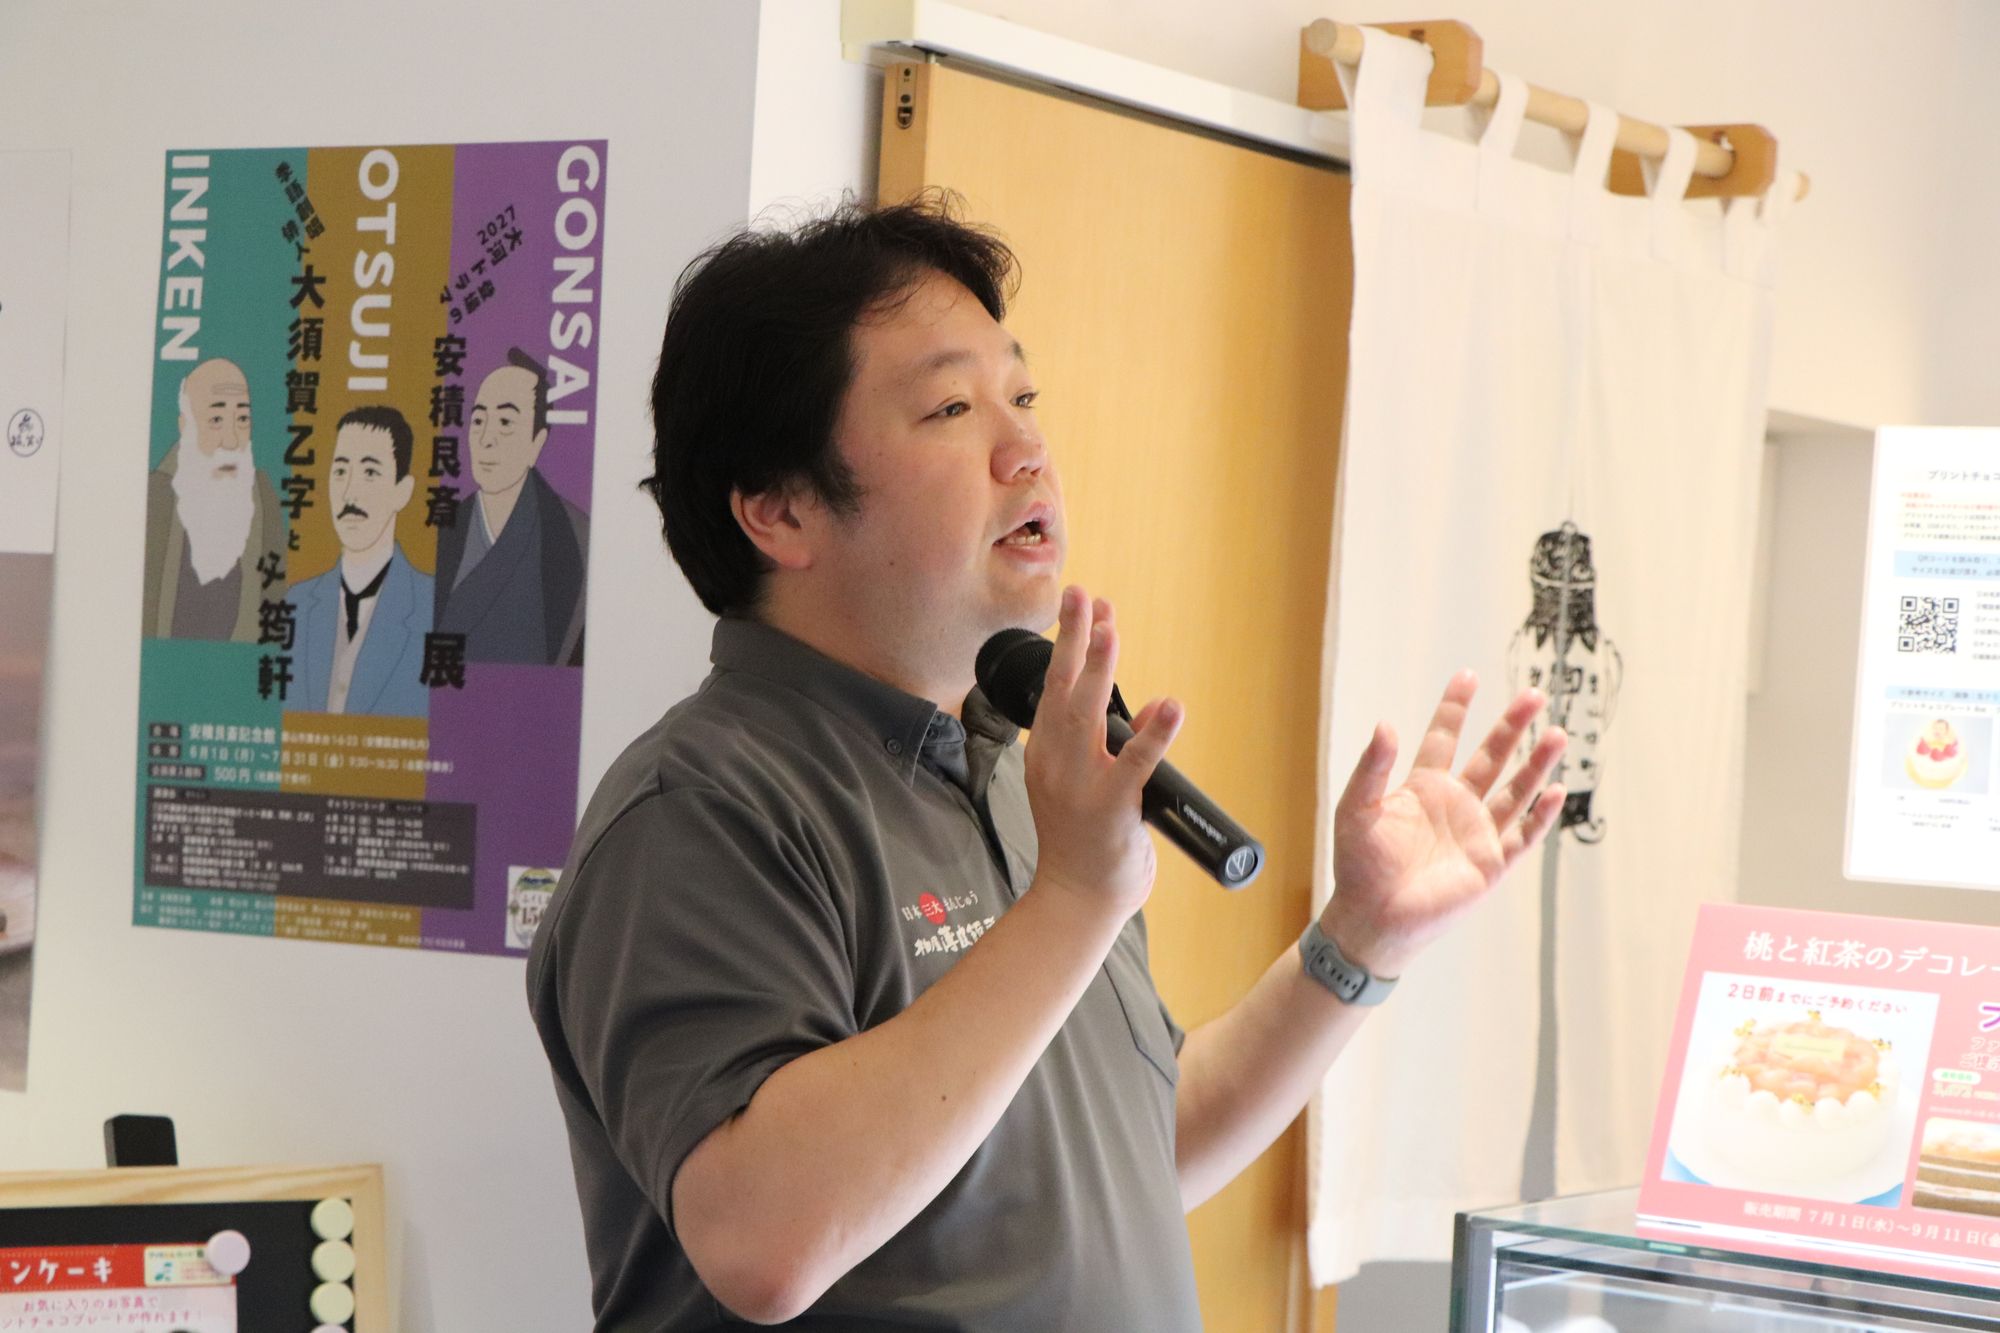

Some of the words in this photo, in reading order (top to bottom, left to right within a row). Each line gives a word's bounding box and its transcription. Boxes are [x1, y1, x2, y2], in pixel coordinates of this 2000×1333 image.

[477, 204, 516, 245] 2027
[161, 155, 210, 361] INKEN
[348, 149, 399, 391] OTSUJI
[546, 145, 600, 425] GONSAI
[419, 632, 466, 690] 展
[1743, 930, 2000, 978] 桃と紅茶のデコレ
[1728, 983, 1909, 1014] 2日前までにご予約ください
[1743, 1201, 1802, 1222] 販売期間
[10, 1256, 113, 1285] ンケーキ
[24, 1295, 159, 1313] お気に入りのお写真で
